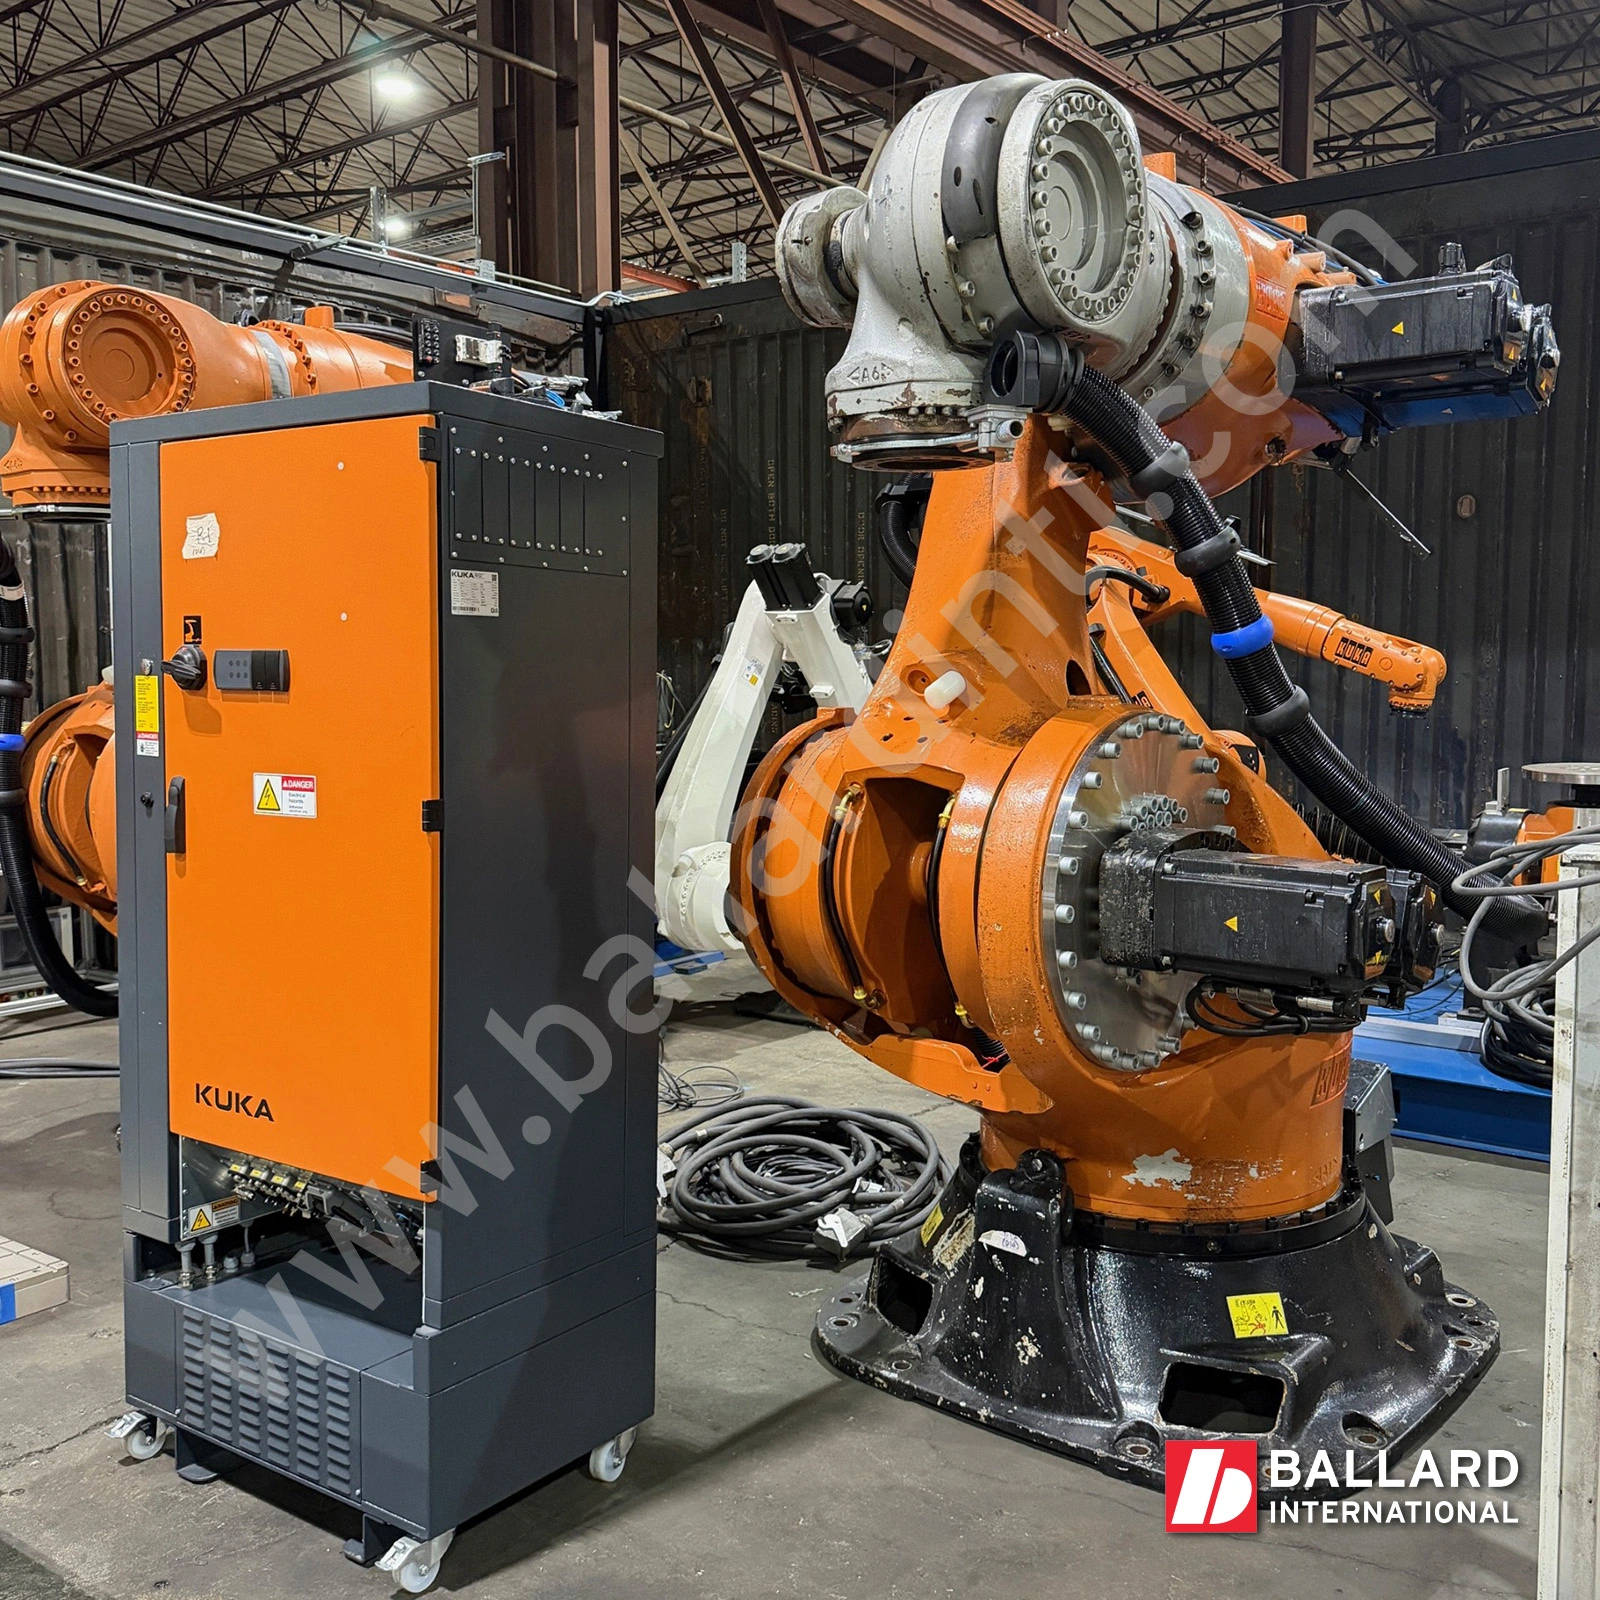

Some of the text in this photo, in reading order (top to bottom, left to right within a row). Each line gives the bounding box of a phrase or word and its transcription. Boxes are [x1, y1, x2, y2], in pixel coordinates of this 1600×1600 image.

[451, 571, 474, 579] KUKA
[1335, 639, 1373, 667] KUKA
[287, 779, 314, 789] DANGER
[195, 1082, 275, 1122] KUKA
